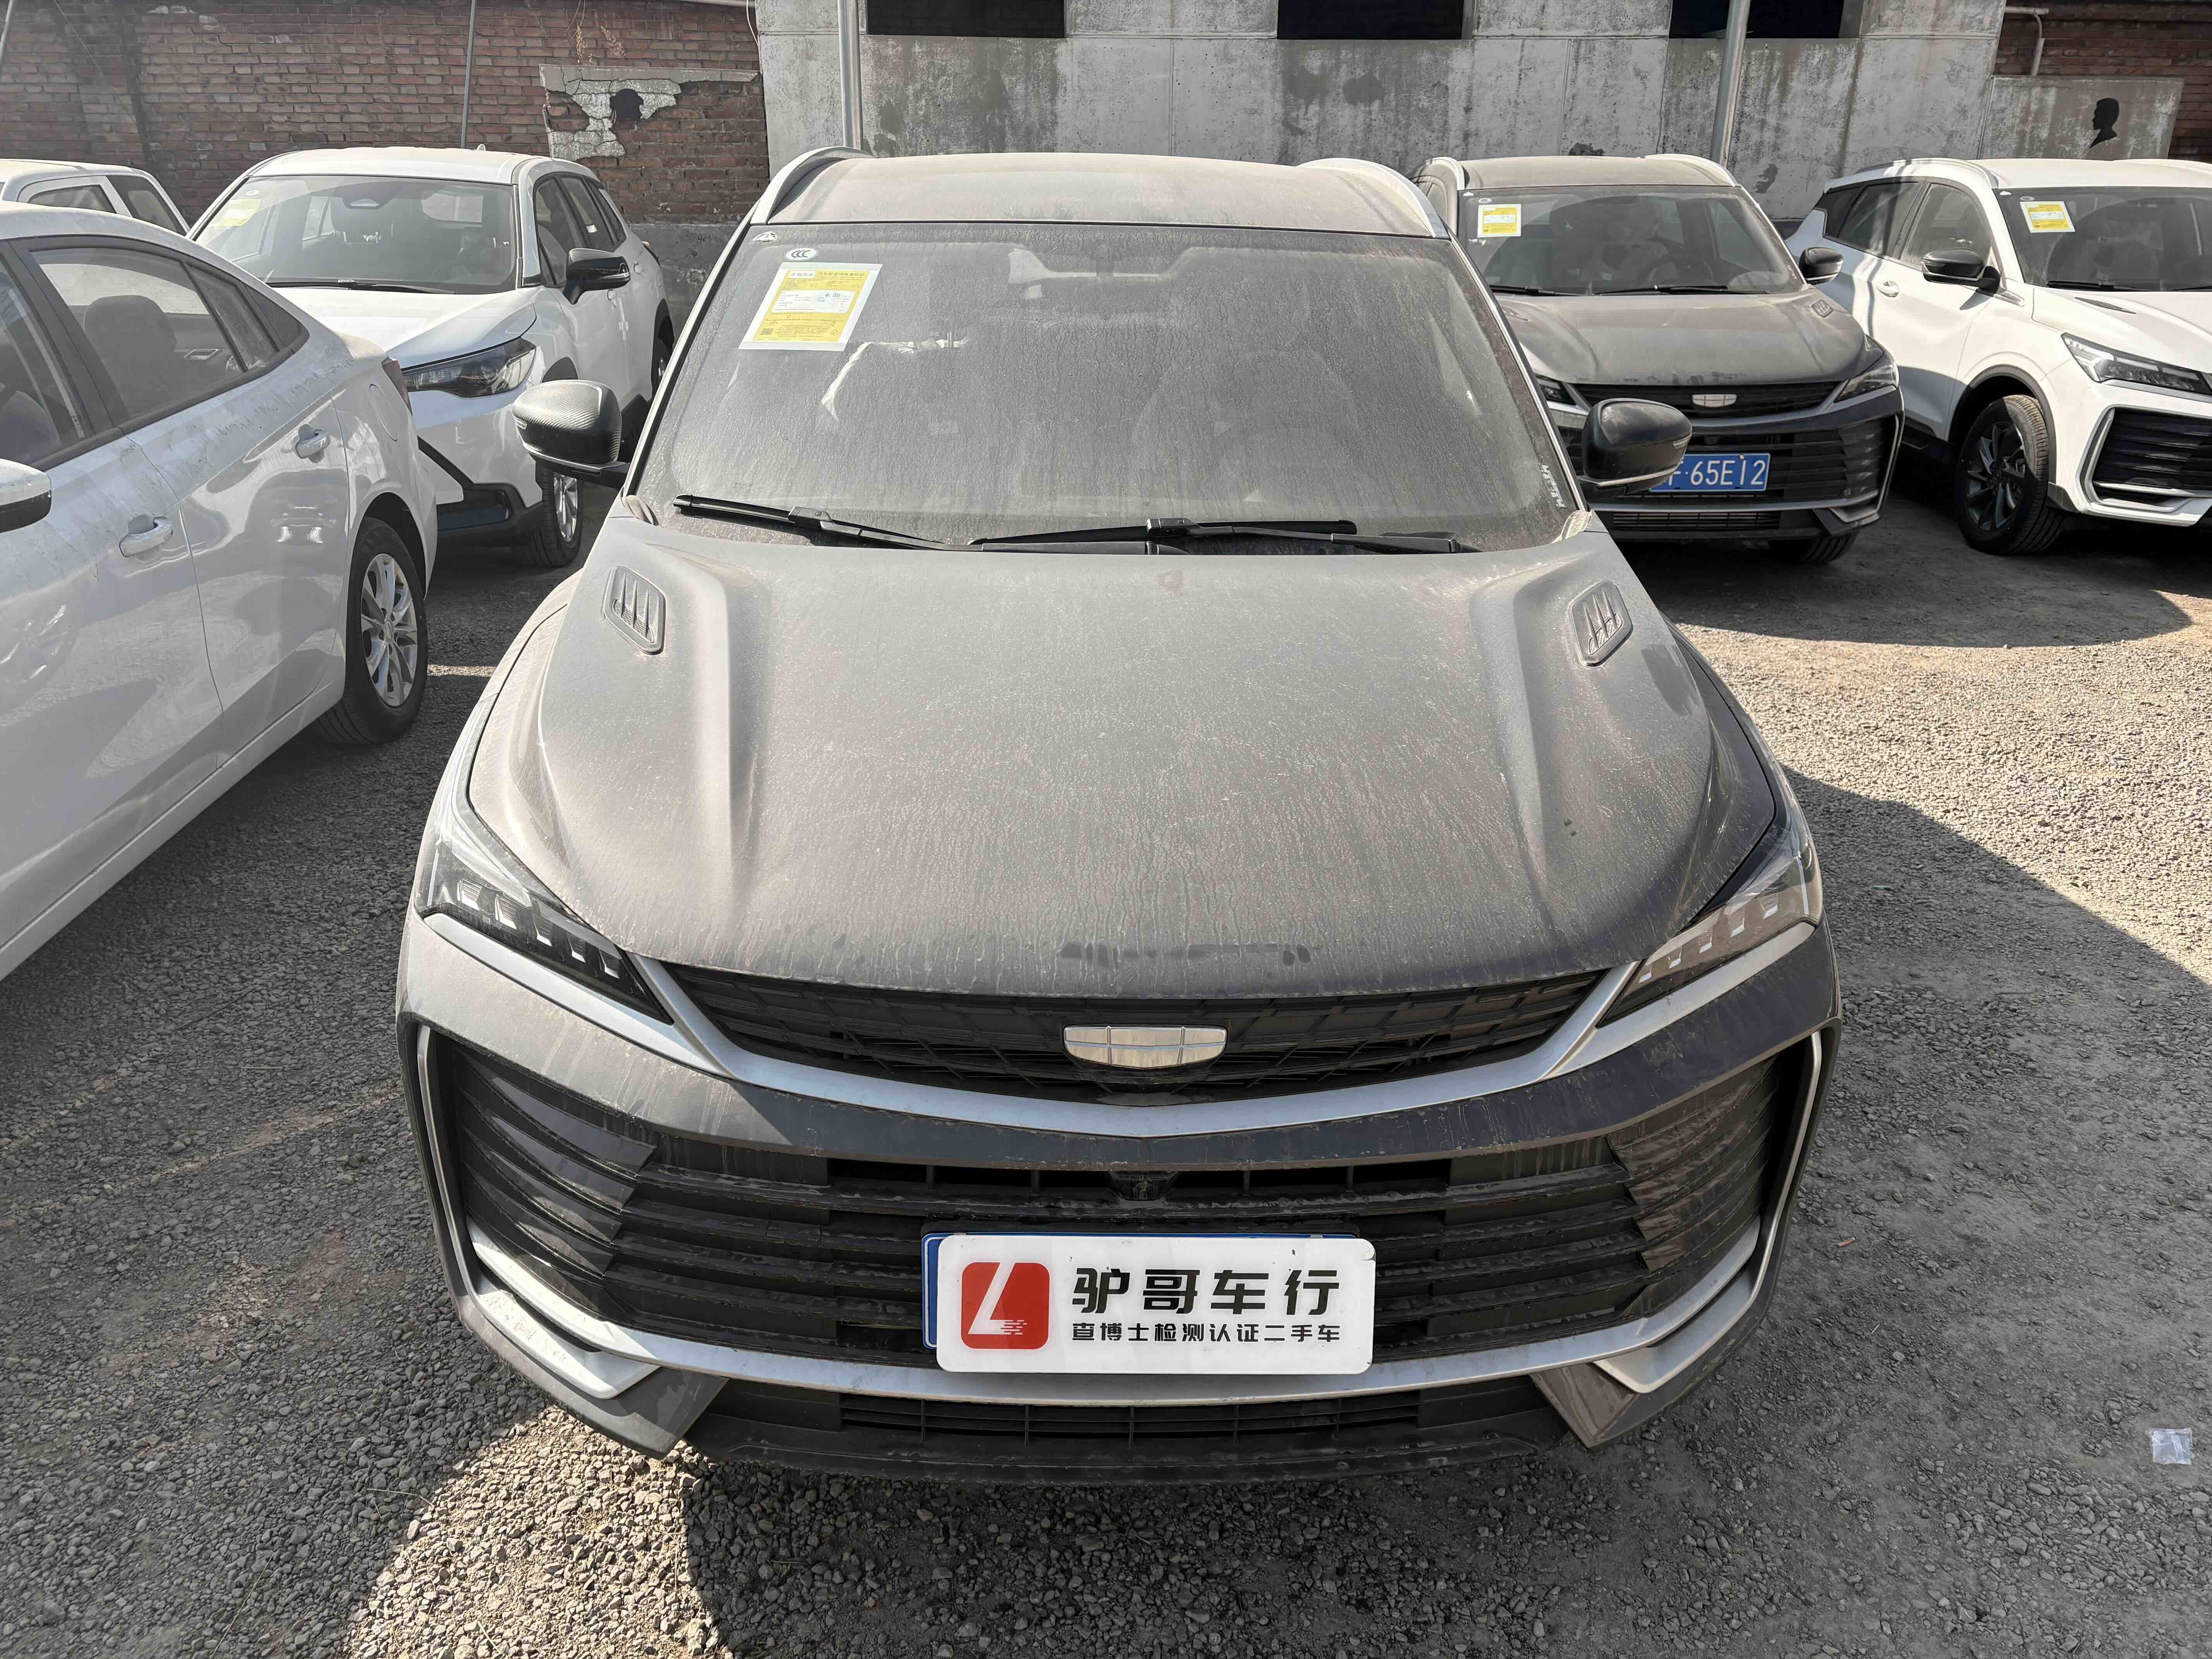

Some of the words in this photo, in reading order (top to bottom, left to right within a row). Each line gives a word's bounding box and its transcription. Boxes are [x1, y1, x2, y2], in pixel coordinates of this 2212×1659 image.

[1072, 1267, 1340, 1316] 驴哥车行
[1072, 1322, 1340, 1342] 查博士检测认证二手车
